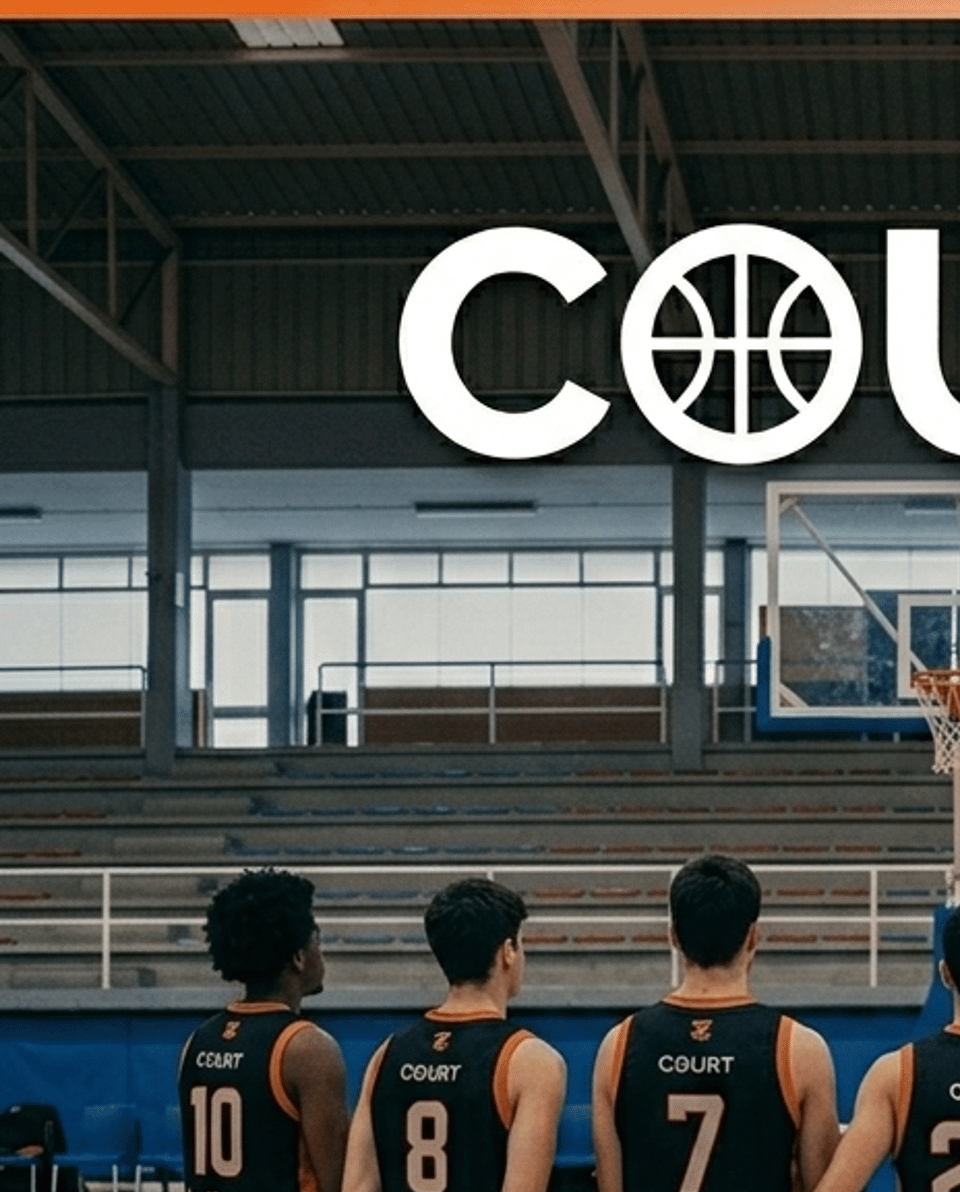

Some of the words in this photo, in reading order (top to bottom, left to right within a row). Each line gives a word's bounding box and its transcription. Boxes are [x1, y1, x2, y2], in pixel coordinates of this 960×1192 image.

[400, 1063, 462, 1082] COURT
[658, 1054, 735, 1074] COURT
[190, 1086, 242, 1177] 10
